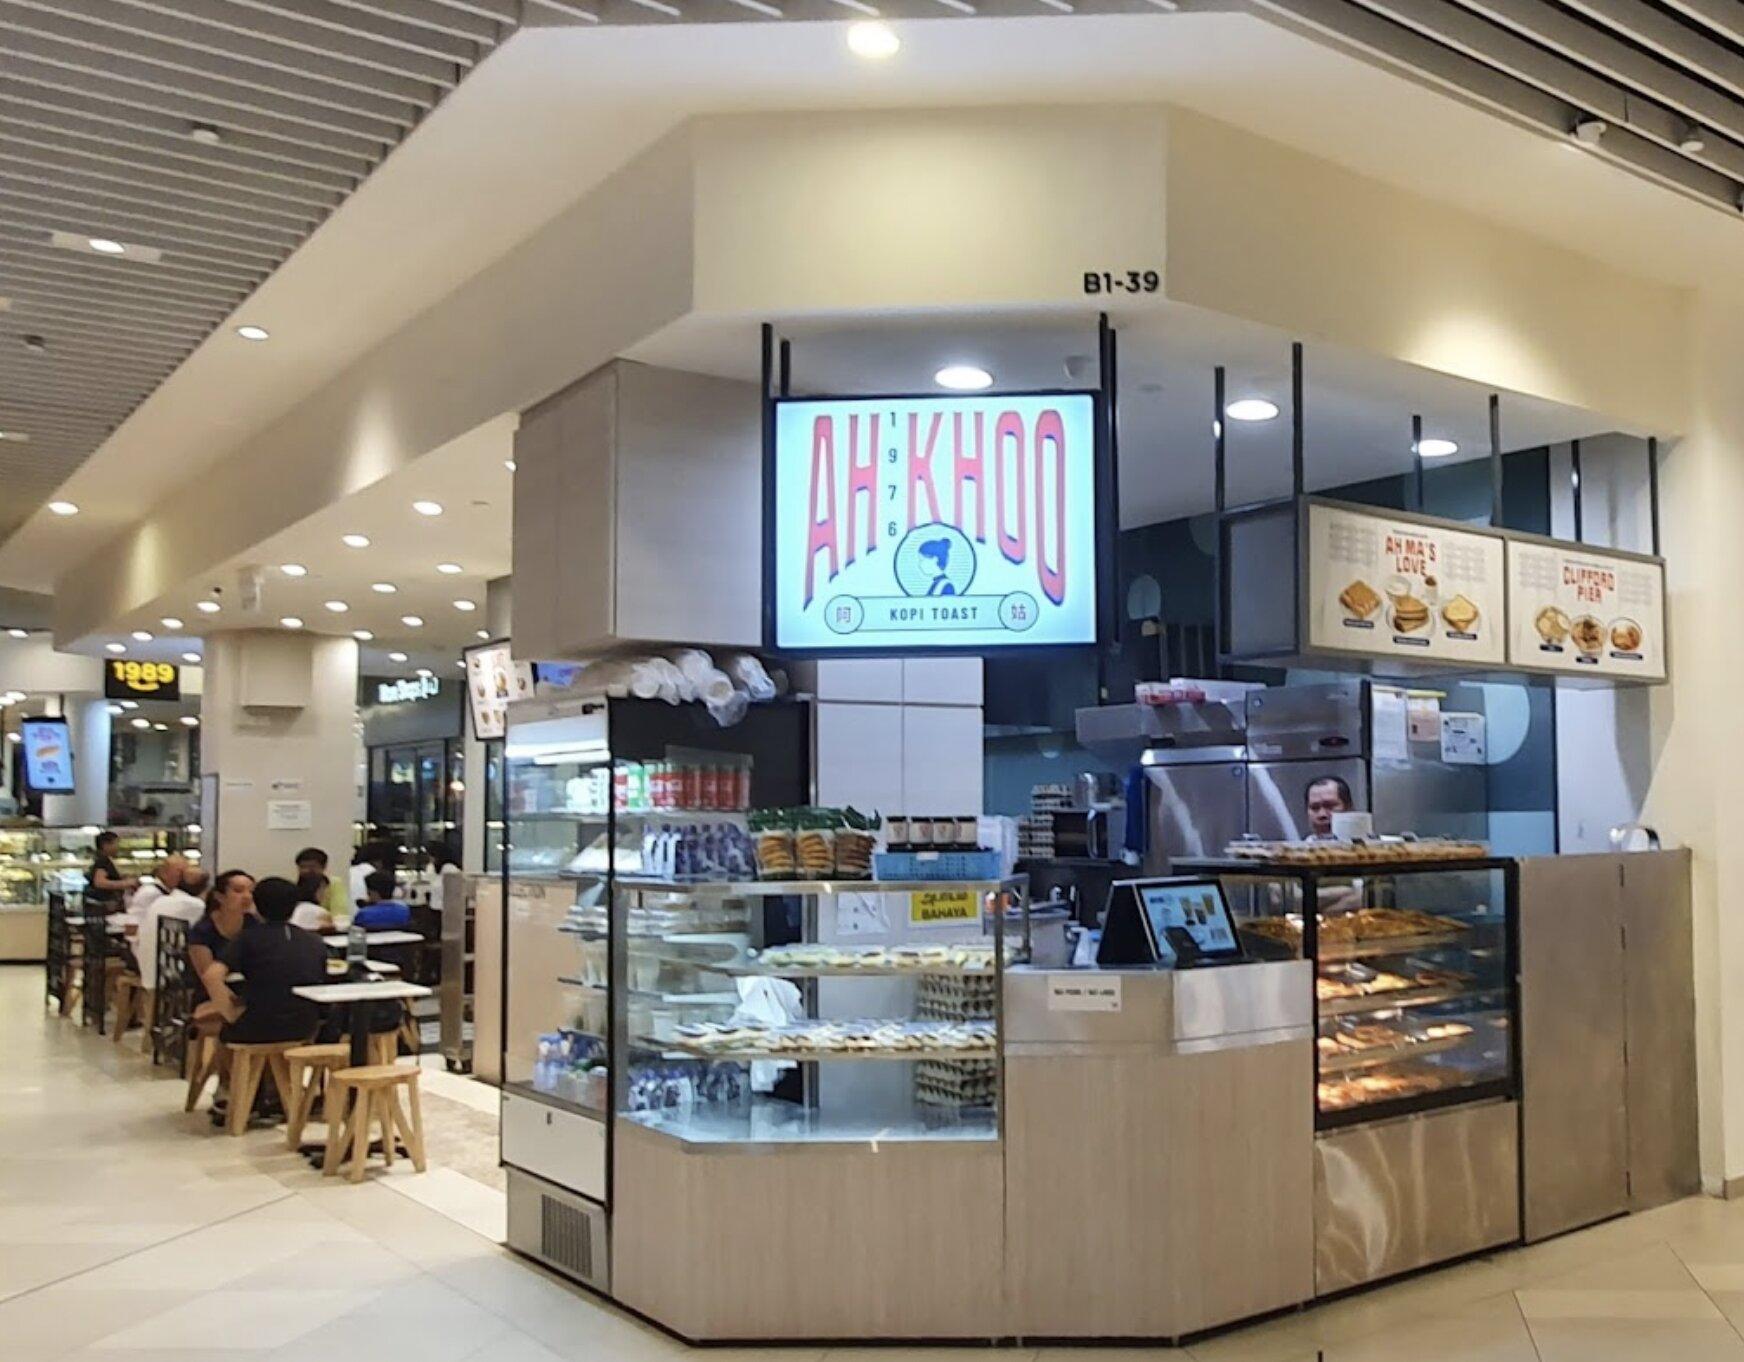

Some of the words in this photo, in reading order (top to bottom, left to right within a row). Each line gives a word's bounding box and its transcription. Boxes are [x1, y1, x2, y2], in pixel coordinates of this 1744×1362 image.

[1083, 270, 1160, 294] B1-39
[803, 413, 880, 613] AH
[906, 408, 1067, 607] KHOO
[1386, 535, 1403, 554] AH
[1395, 555, 1427, 577] LOVE
[1577, 583, 1602, 603] PIER
[889, 607, 925, 621] KOPI
[931, 606, 978, 620] TOAST
[112, 660, 175, 683] 1989
